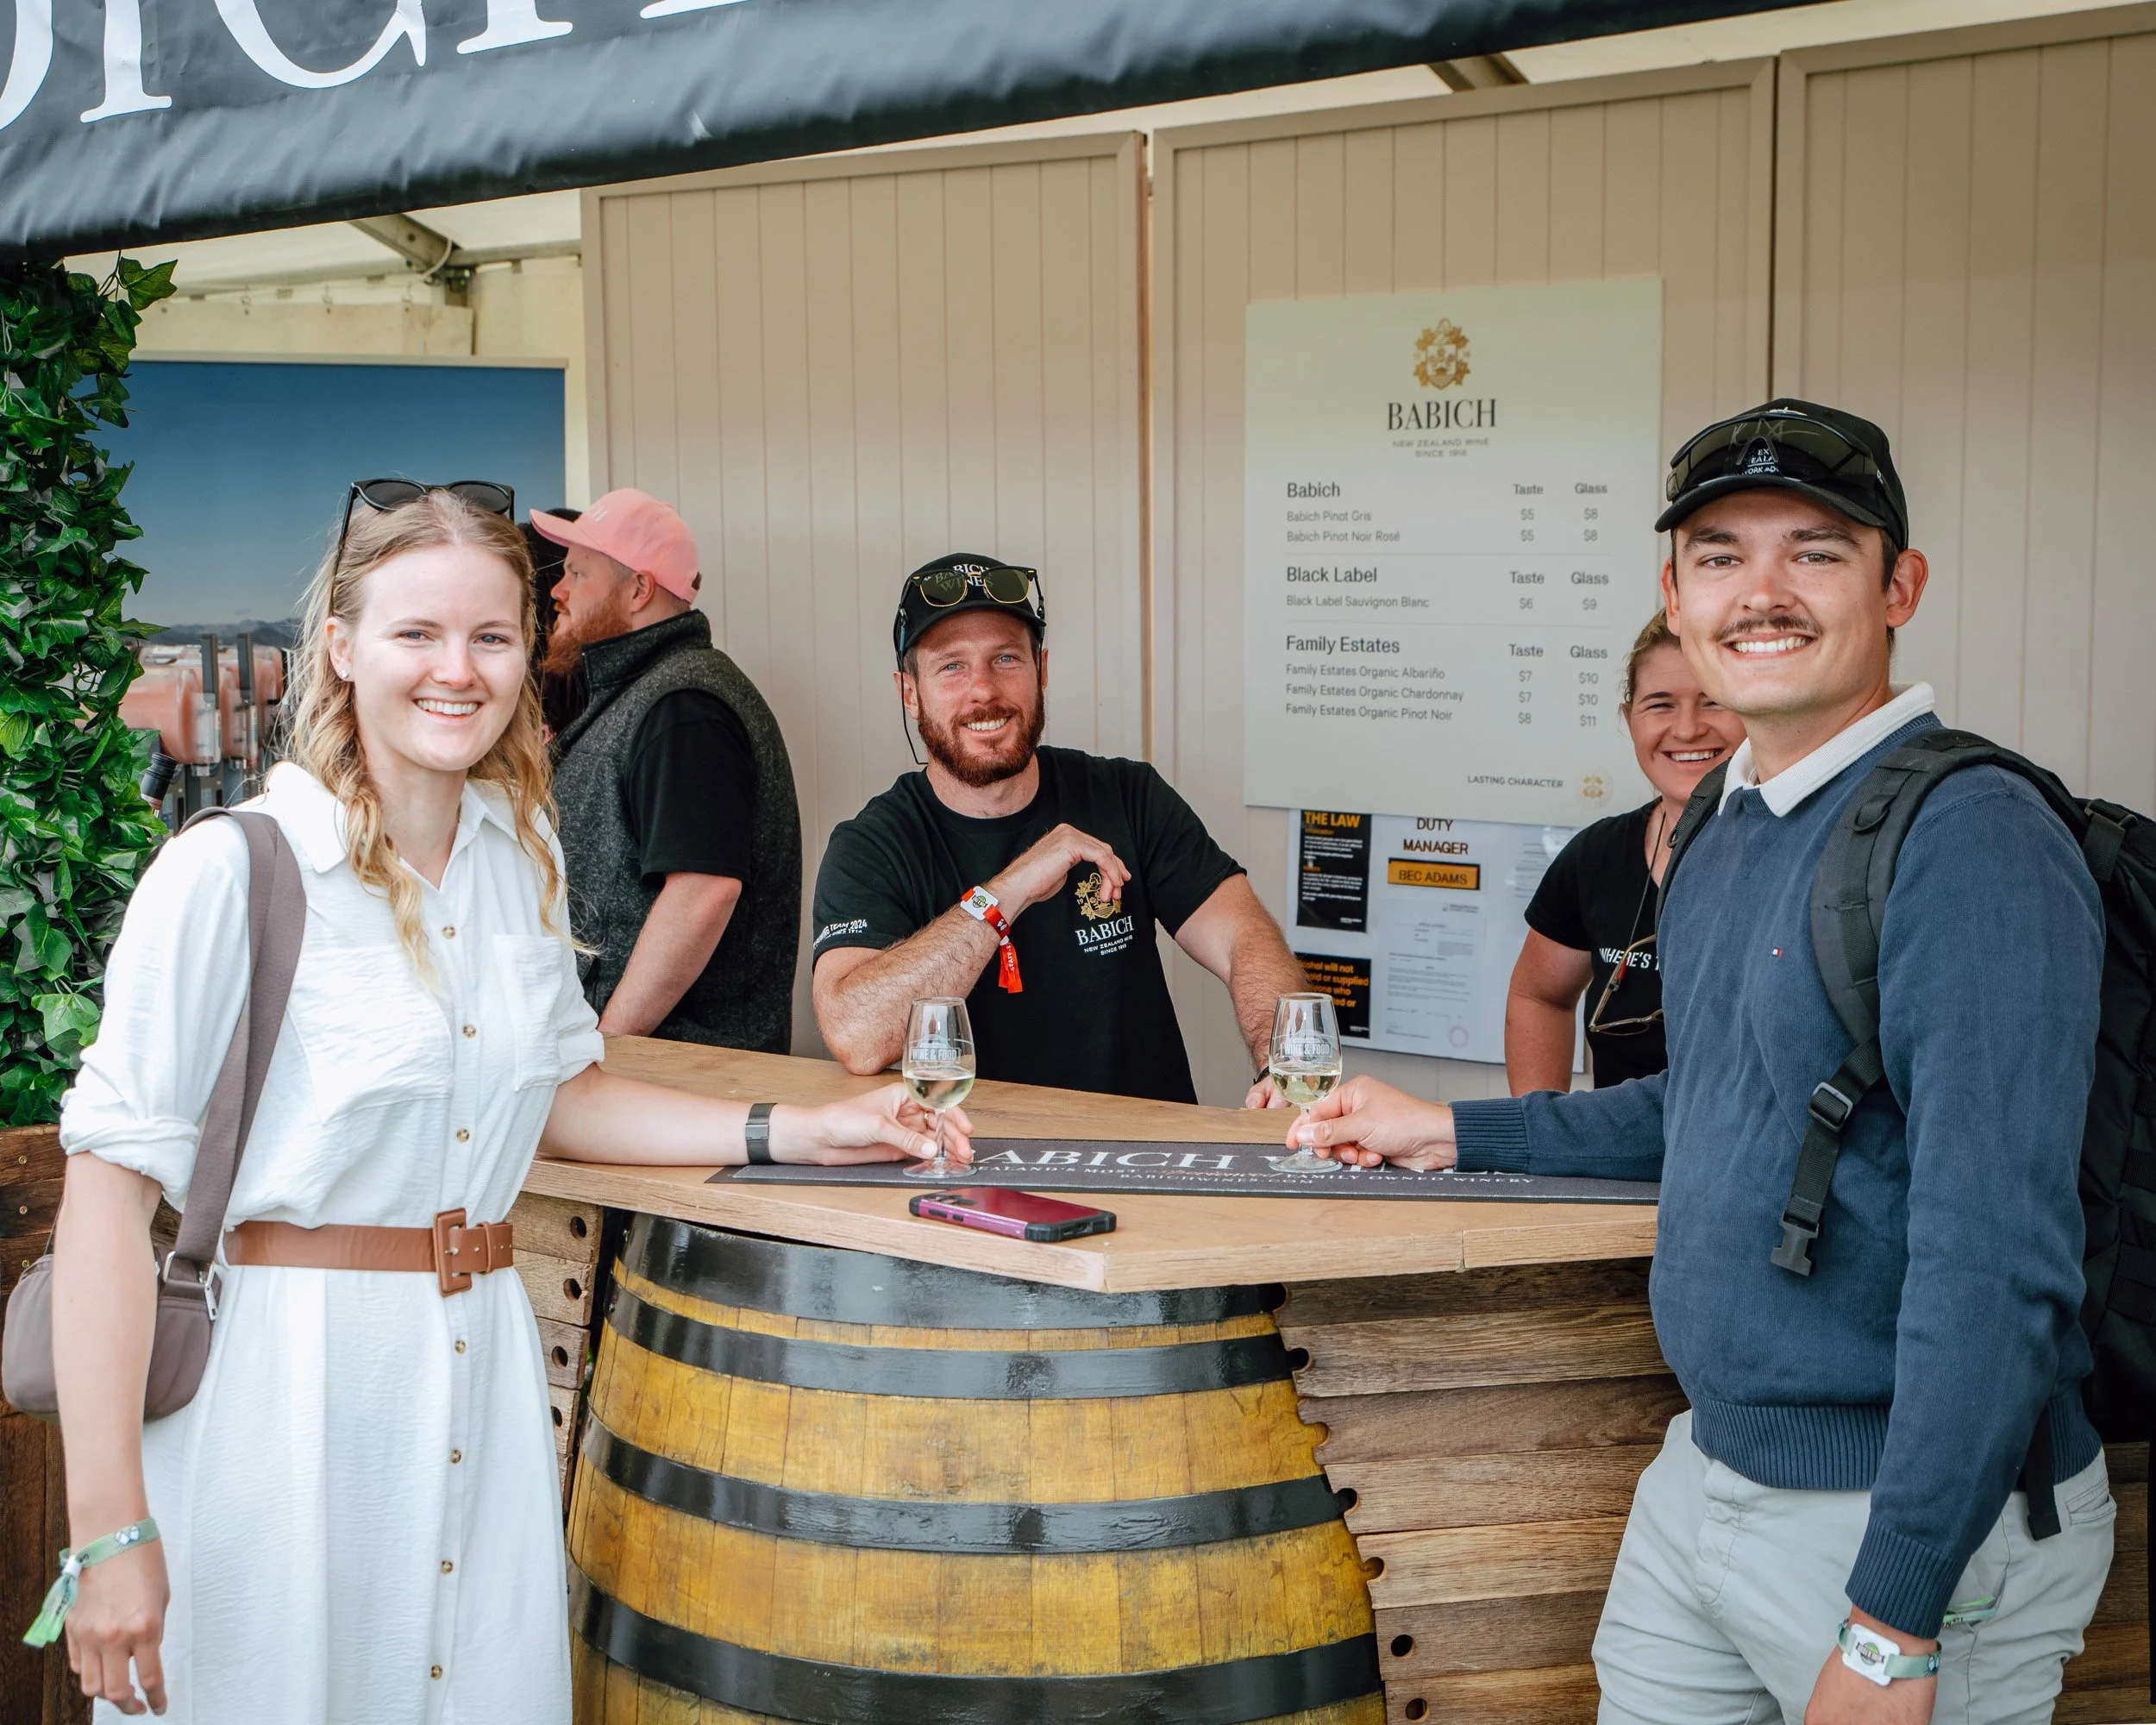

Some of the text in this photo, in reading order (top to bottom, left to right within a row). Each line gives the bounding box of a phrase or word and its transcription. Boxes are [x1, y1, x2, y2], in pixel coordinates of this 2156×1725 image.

[1388, 398, 1497, 430] BABICH
[1417, 438, 1462, 448] ZEALAND
[1466, 437, 1489, 446] WINE
[1288, 481, 1340, 498] Babich
[1514, 482, 1608, 495] Taste Glass
[1287, 510, 1372, 522] Babich Pinot Gris
[1520, 507, 1598, 521] $5 $8
[1287, 530, 1401, 543] Babich Pinot Noir Rosé
[1520, 529, 1598, 542] $5 $8
[1287, 566, 1377, 582] Black Label
[1509, 570, 1609, 585] Taste Glass
[1287, 595, 1429, 609] Black Label Sauvignon Blanc
[1520, 597, 1597, 611] $6 $9
[1287, 636, 1401, 655] Family Estates
[1508, 643, 1608, 659] Taste Glass
[1286, 663, 1445, 680] Family Estates Organic Albariño
[1519, 670, 1599, 685] $7 $10
[1286, 684, 1464, 702] Family Estates Organic Chardonnay
[1519, 691, 1598, 706] $7 $10
[1286, 704, 1453, 720] Family Estates Organic Pinot Noir
[1518, 712, 1596, 727] $8 $11
[1468, 775, 1564, 788] LASTING CHARACTER
[1304, 812, 1361, 828] THE LAW
[1417, 817, 1453, 831] DUTY
[1403, 838, 1469, 855] MANAGER
[1399, 869, 1468, 885] BEC ADAMS
[830, 922, 849, 932] TEAM
[850, 919, 868, 930] 2024
[1075, 915, 1134, 946] BABICH
[1100, 938, 1124, 950] ZEALAND
[1100, 946, 1117, 956] SINCE
[1324, 963, 1338, 972] will
[1339, 964, 1353, 974] not
[1332, 975, 1369, 986] supplied
[1333, 986, 1351, 996] who
[912, 1048, 957, 1060] WINE & FOOD
[1284, 1044, 1330, 1056] WINE & FOOD
[972, 1150, 1239, 1170] ABICH
[1120, 1174, 1313, 1184] BABICHWINES.COM
